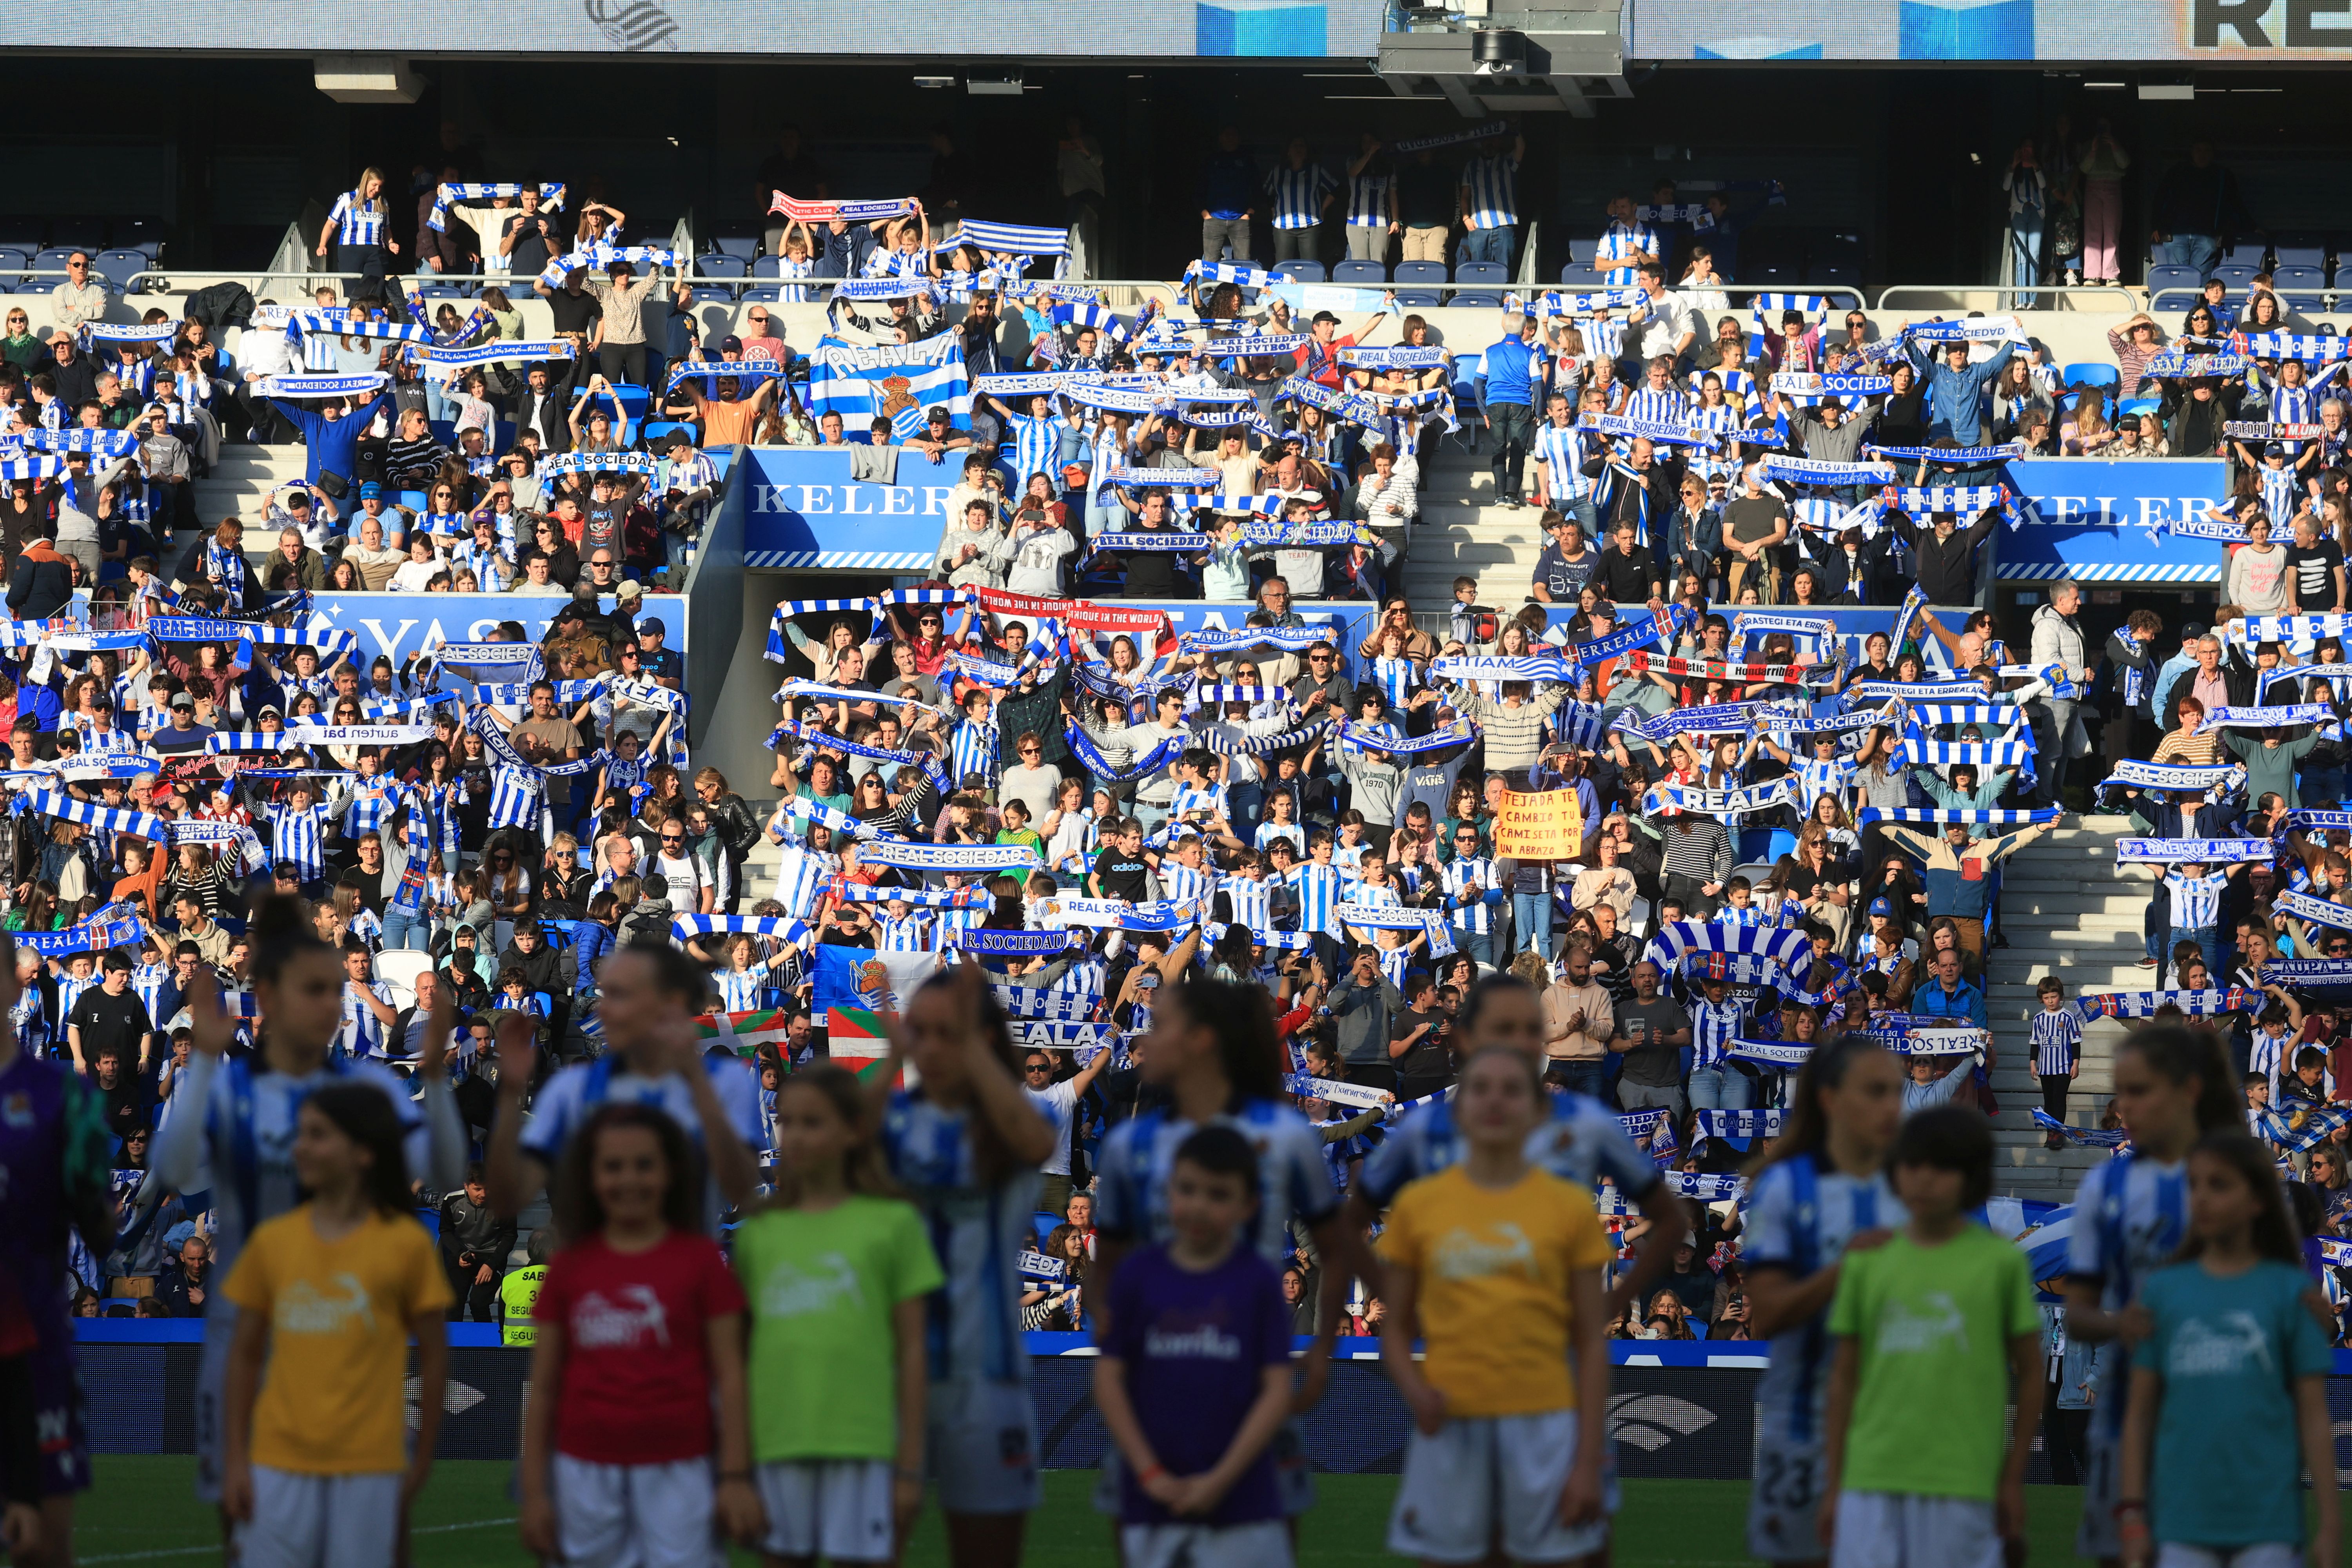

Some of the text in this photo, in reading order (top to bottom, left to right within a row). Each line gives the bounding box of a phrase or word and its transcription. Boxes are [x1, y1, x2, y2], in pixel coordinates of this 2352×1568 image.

[864, 203, 896, 212] SOCIEDAD
[1034, 283, 1096, 300] SOCIEDAD
[1528, 291, 1646, 311] REAL SOCIEDAD
[1255, 334, 1308, 344] SOCIEDAD
[2252, 339, 2345, 353] REAL SOCIEDAD
[828, 343, 947, 381] REALA
[1360, 351, 1440, 362] REAL SOCIEDAD
[2148, 356, 2180, 373] REAL
[981, 380, 1023, 390] REAL
[1061, 383, 1100, 401] REAL
[1287, 379, 1377, 426] REAL SOCIEDAD
[1602, 417, 1687, 437] REAL SOCIEDAD
[549, 456, 580, 470] REAL
[1774, 457, 1858, 471] LEIALTASUNA
[1138, 468, 1193, 482] REALA
[752, 485, 950, 515] KELER
[1902, 492, 1997, 505] REAL SOCIEDAD
[1245, 524, 1353, 541] REAL SOCIEDAD
[1100, 536, 1132, 546] REAL
[983, 594, 1074, 611] UNIQUE IN THE WORLD
[1101, 612, 1159, 624] IN THE WORLD
[150, 620, 190, 637] REAL
[1199, 627, 1320, 643] AUPA ERREALA
[2251, 621, 2292, 637] REAL
[1581, 625, 1656, 659] ERREALA
[1640, 654, 1794, 677] Peña Athletic Hondarribia
[1083, 672, 1108, 694] REAL
[1868, 686, 1933, 695] BERASTEGI ETA
[1655, 719, 1722, 738] DE FUTBOL
[1771, 719, 1810, 731] REAL
[1075, 743, 1085, 757] WE
[62, 757, 149, 769] REAL SOCIEDAD
[176, 756, 216, 779] Athletic
[614, 768, 635, 777] CAZOO
[508, 774, 537, 790] CAZOO
[1366, 780, 1383, 788] 1970
[1416, 774, 1445, 786] VANS
[1505, 794, 1553, 806] TEJADA
[1682, 780, 1786, 811] REALA
[1506, 811, 1575, 823] CAMBIO TU
[1501, 827, 1579, 840] CAMISETA POR
[883, 848, 1022, 865] REAL SOCIEDAD
[1501, 844, 1512, 854] UN
[1520, 844, 1555, 855] ABRAZO
[811, 859, 835, 873] YASUDA
[1112, 863, 1144, 872] adidas
[847, 882, 877, 893] REAL
[1069, 902, 1100, 913] REAL
[1104, 904, 1165, 923] SOCIEDAD
[1343, 906, 1378, 922] REAL
[2295, 897, 2337, 922] REAL
[965, 932, 1065, 950] R. SOCIEDAD
[1729, 962, 1763, 976] REAL
[2280, 960, 2337, 974] AUPA
[137, 976, 160, 984] CAZOO
[1026, 996, 1093, 1014] SOCIEDAD
[2120, 998, 2154, 1008] REAL
[1743, 1045, 1768, 1053] REAL
